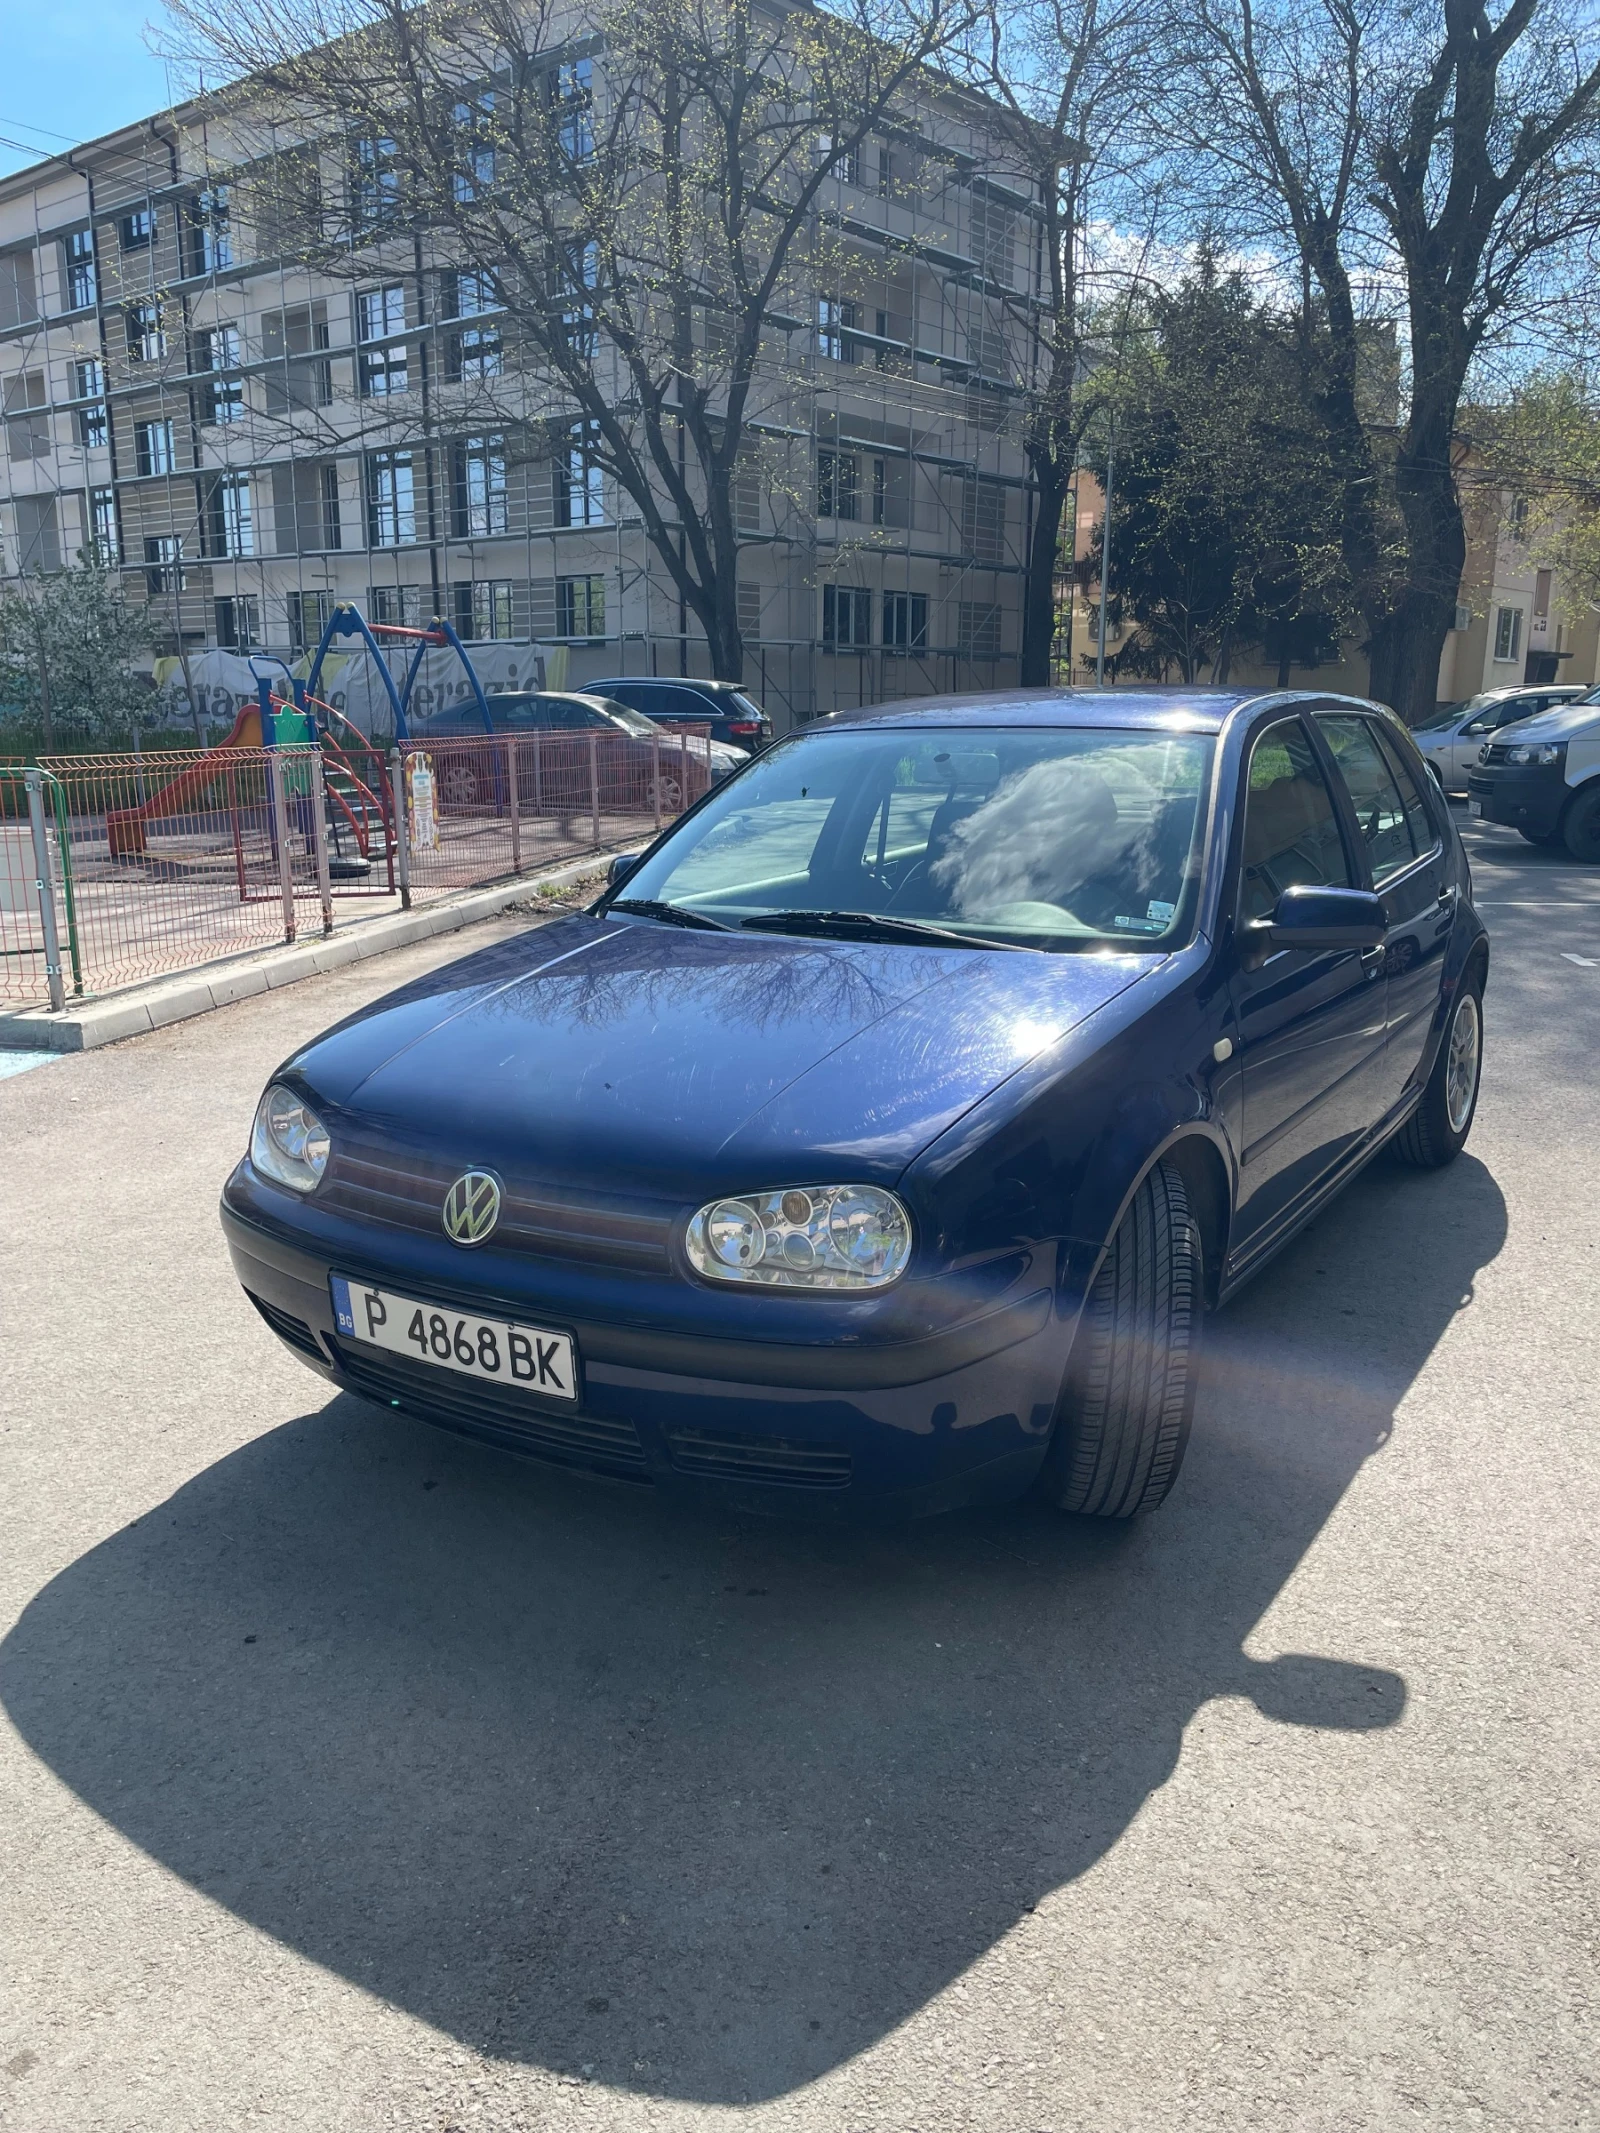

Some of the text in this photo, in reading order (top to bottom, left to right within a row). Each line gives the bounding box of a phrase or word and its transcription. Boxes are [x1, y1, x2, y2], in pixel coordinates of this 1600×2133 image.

[443, 1172, 500, 1243] VW
[338, 1312, 353, 1329] BG
[364, 1293, 565, 1390] P 4868 BK
